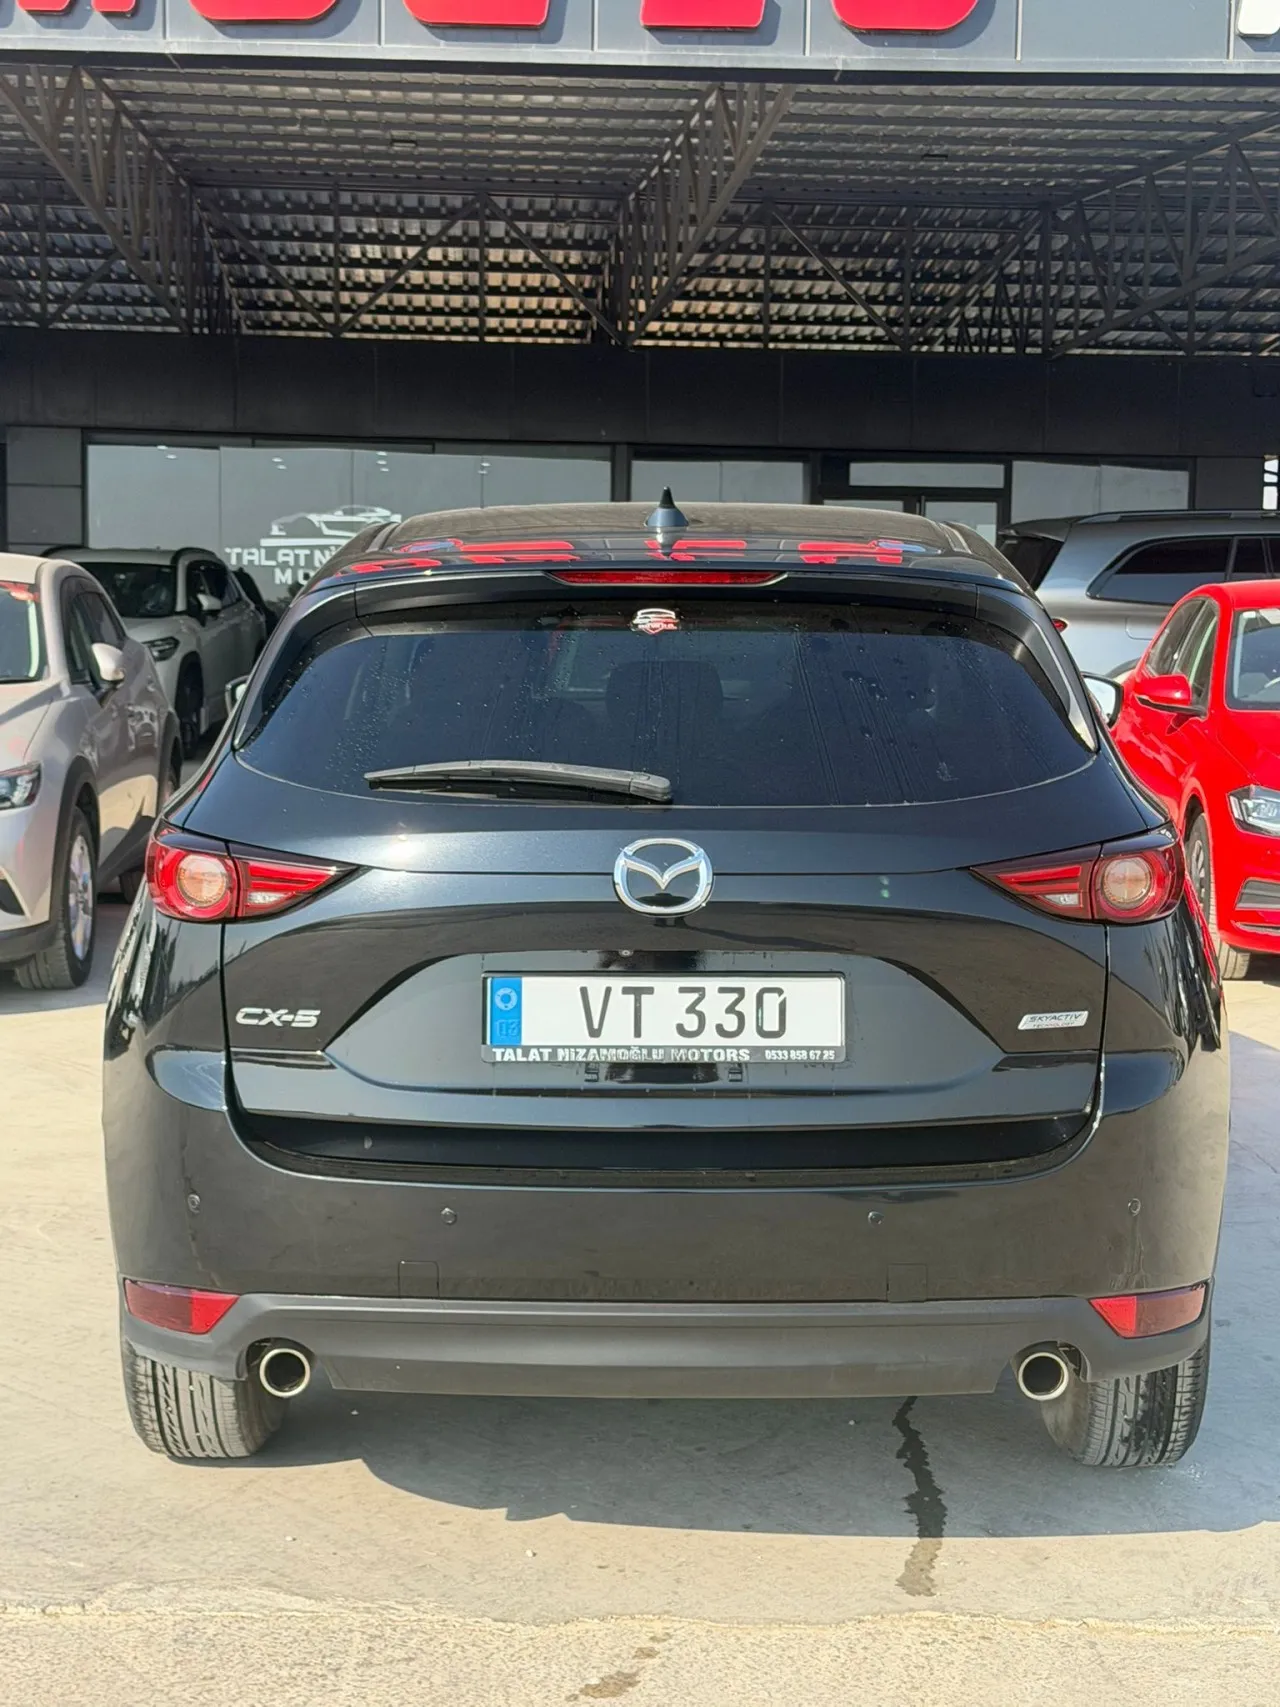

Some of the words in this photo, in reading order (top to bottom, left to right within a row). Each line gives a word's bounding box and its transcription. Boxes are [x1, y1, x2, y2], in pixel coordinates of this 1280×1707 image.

[224, 547, 311, 567] TALAT
[235, 1007, 321, 1028] CX-5
[579, 985, 655, 1039] VT
[675, 985, 788, 1039] 330
[1029, 1013, 1082, 1023] SKYACTIV
[492, 1047, 552, 1061] TALAT
[671, 1048, 750, 1062] MOTORS
[765, 1049, 789, 1061] 0533
